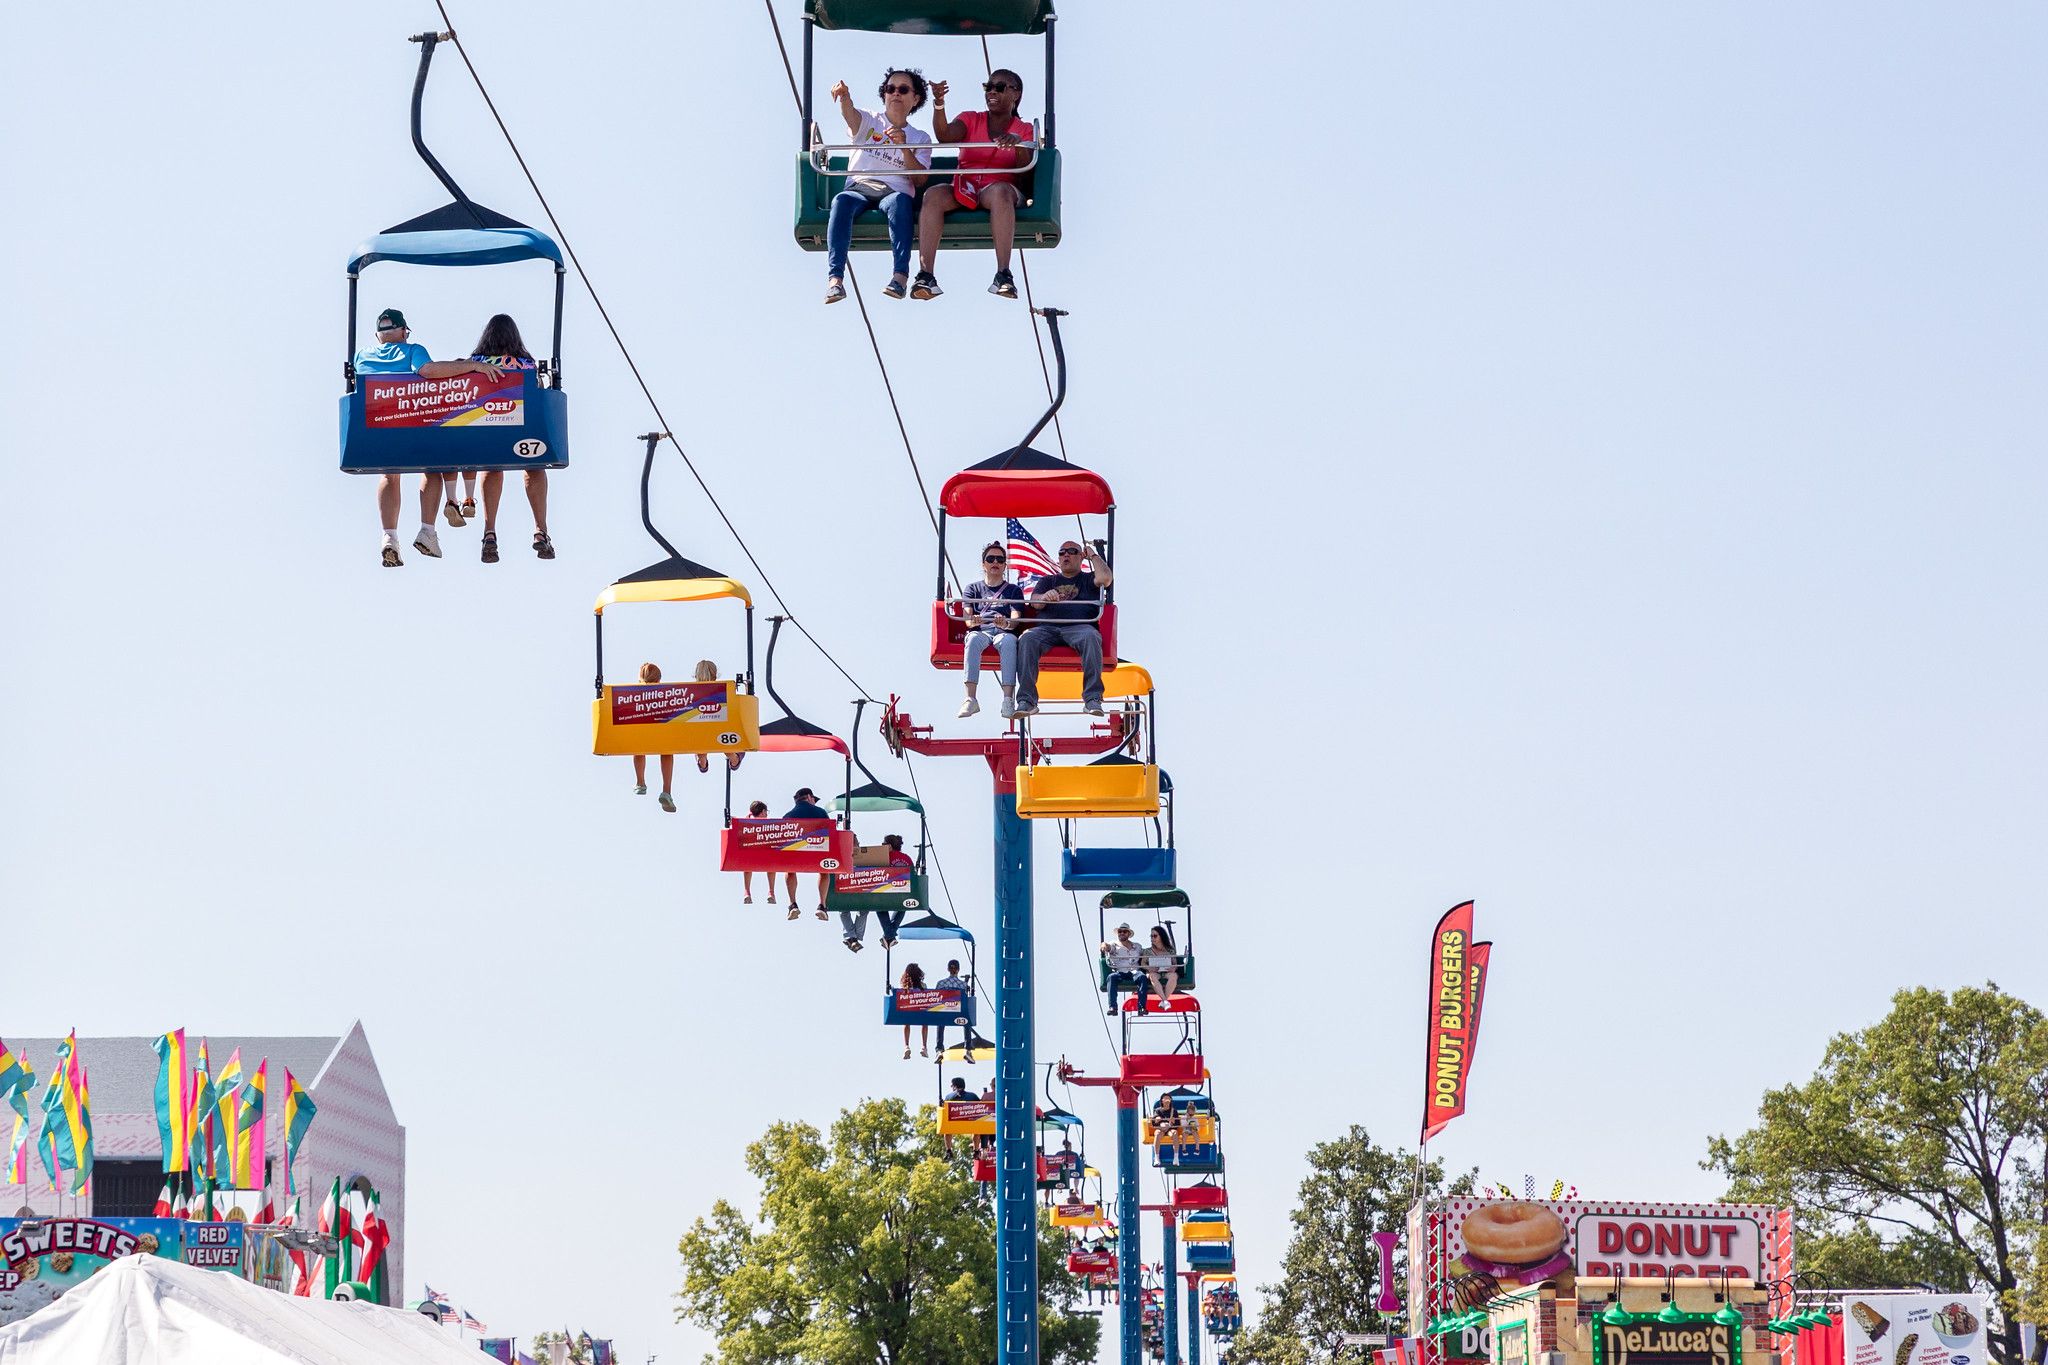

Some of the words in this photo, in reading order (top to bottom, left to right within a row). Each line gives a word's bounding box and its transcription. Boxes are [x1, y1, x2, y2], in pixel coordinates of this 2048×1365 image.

[374, 387, 394, 400] Put
[396, 387, 405, 396] a
[407, 381, 437, 395] little
[439, 378, 470, 393] play
[398, 398, 410, 409] in
[412, 395, 443, 410] your
[444, 386, 479, 403] day!
[484, 400, 513, 411] OH!
[519, 442, 540, 455] 87
[617, 695, 633, 704] Put
[642, 690, 664, 700] little
[665, 688, 688, 699] play
[636, 703, 644, 711] in
[645, 700, 669, 712] your
[669, 693, 694, 706] day!
[698, 703, 720, 712] OH!
[721, 734, 737, 744] 86
[743, 826, 754, 834] Put
[762, 824, 780, 832] little
[780, 822, 799, 831] play
[764, 831, 783, 840] your
[784, 828, 804, 837] day!
[823, 860, 836, 868] 85
[857, 877, 873, 885] your
[872, 874, 889, 882] day!
[870, 869, 885, 877] play
[1440, 931, 1463, 1030] BURGERS
[1435, 1034, 1462, 1108] DONUT
[3, 1222, 136, 1262] SWEETS
[200, 1227, 227, 1242] RED
[1598, 1222, 1737, 1257] DONUT
[187, 1249, 239, 1264] VELVET
